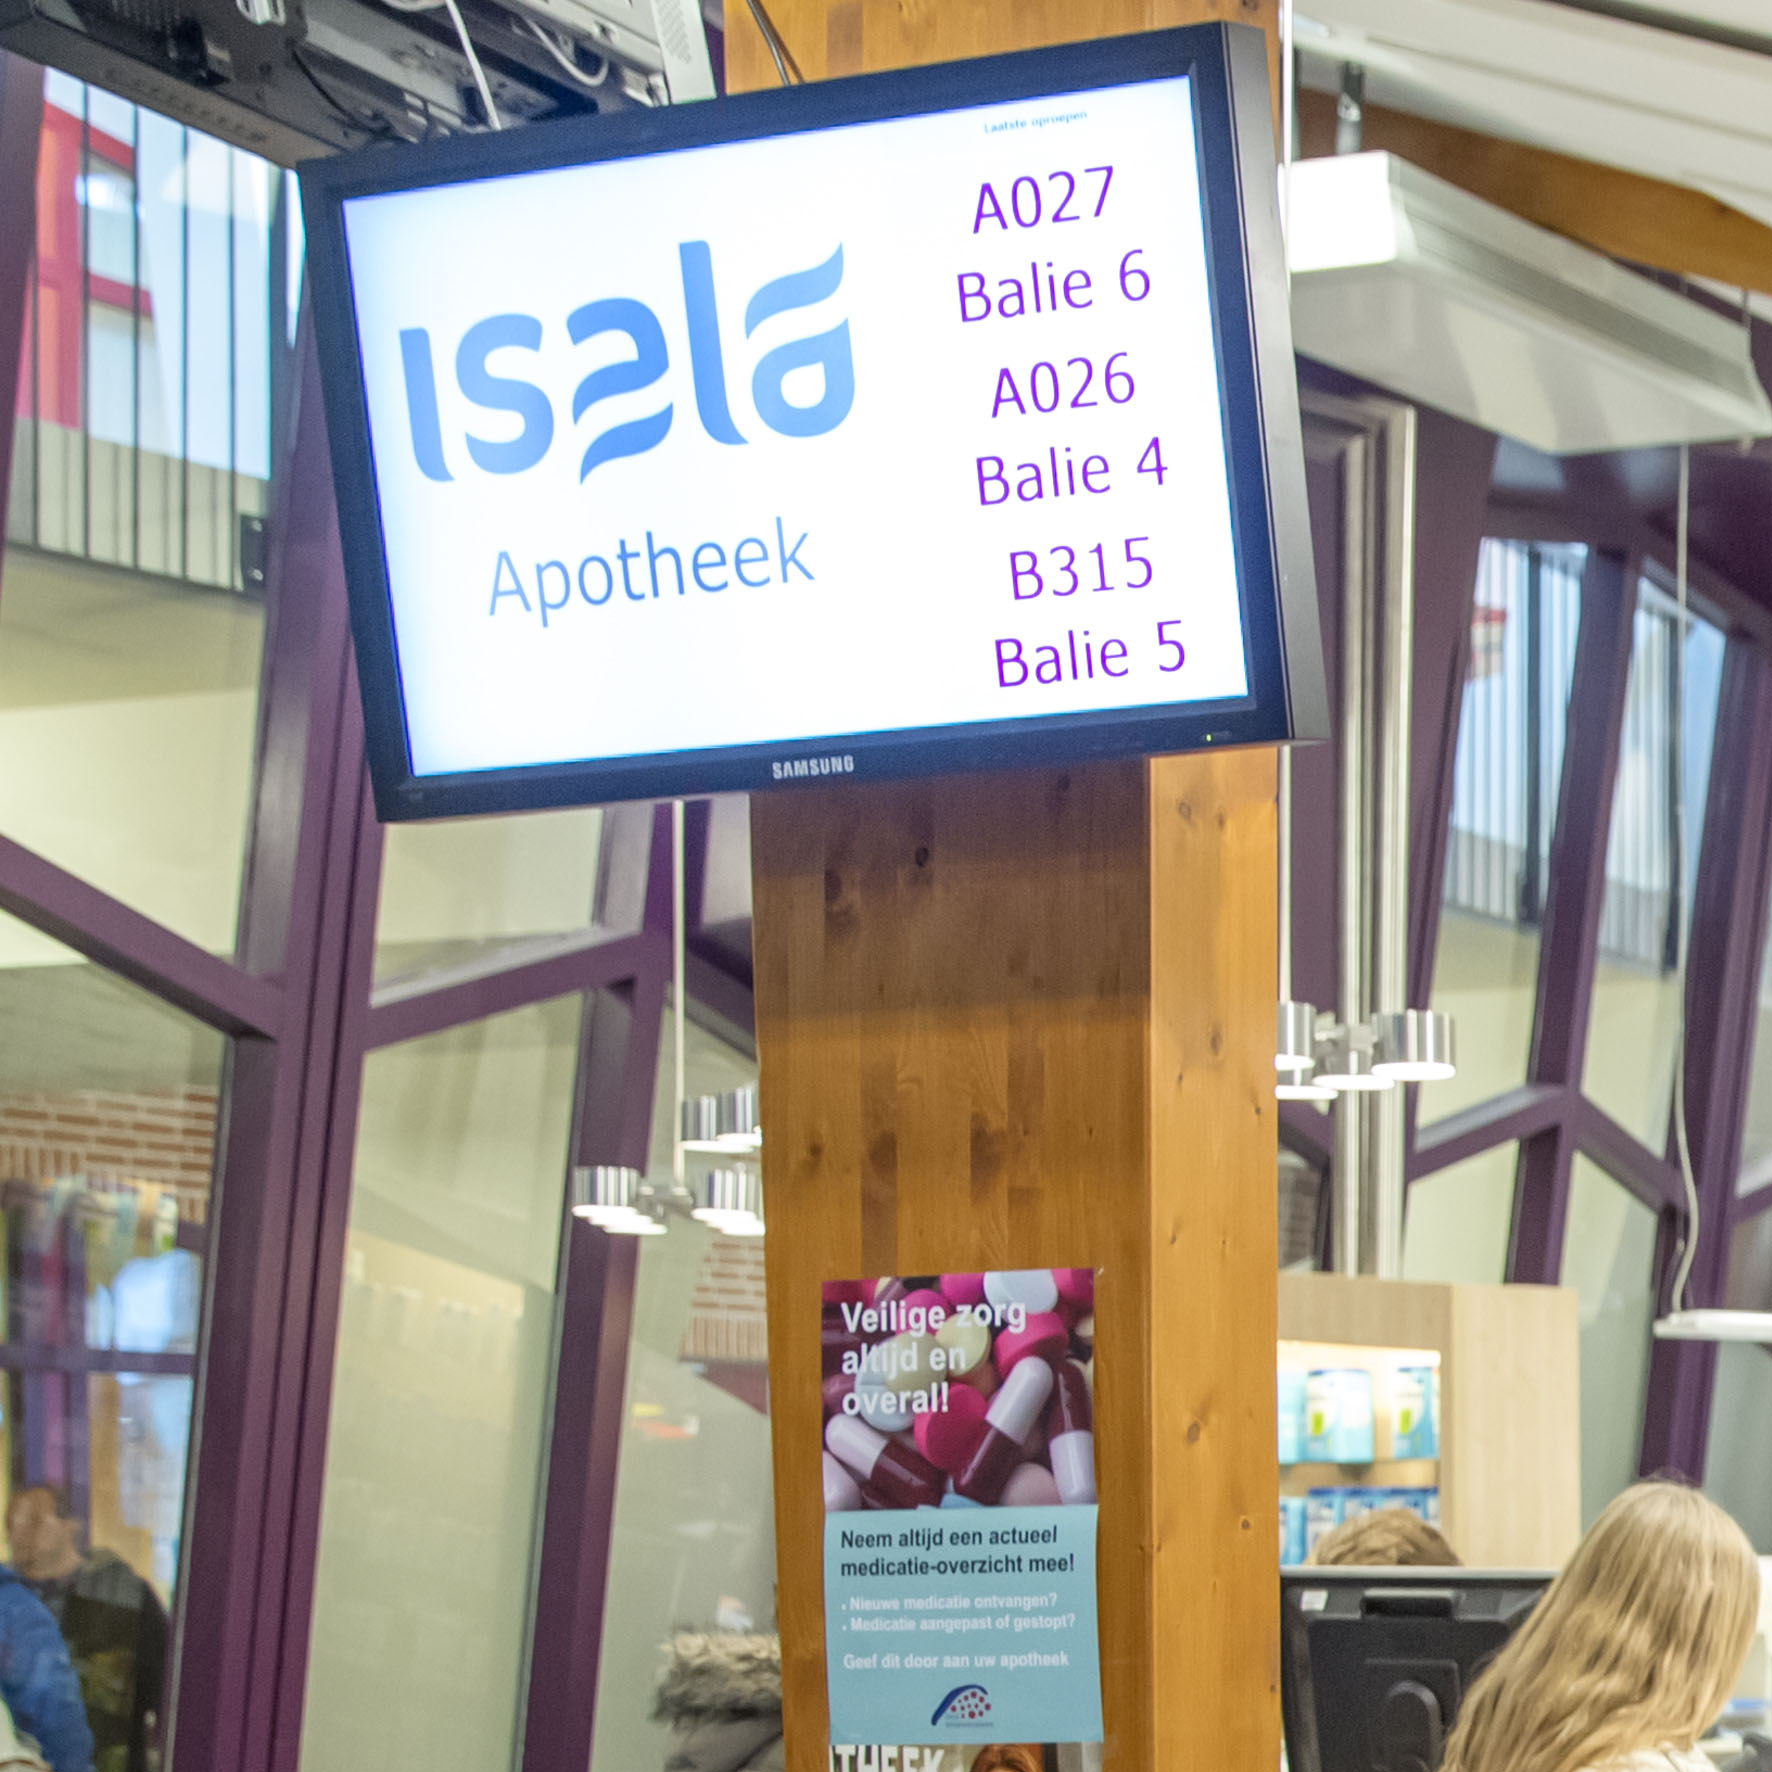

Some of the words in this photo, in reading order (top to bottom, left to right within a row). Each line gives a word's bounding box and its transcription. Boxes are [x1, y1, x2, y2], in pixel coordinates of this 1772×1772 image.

[972, 165, 1114, 235] A027
[956, 261, 1093, 323] Balie
[1119, 248, 1151, 302] 6
[991, 351, 1135, 419] A026
[975, 446, 1111, 507] Balie
[1136, 436, 1169, 486] 4
[489, 516, 815, 628] Apotheek
[1009, 536, 1153, 601] B315
[994, 629, 1129, 688] Balie
[1156, 619, 1185, 673] 5
[772, 754, 854, 780] SAMSUNG
[840, 1300, 946, 1337] Veilige
[955, 1302, 1026, 1334] zorg
[841, 1342, 918, 1381] altijd
[928, 1346, 967, 1372] en
[842, 1381, 949, 1416] overal!
[840, 1530, 893, 1549] Neem
[898, 1528, 944, 1551] altijd
[949, 1530, 983, 1545] een
[989, 1525, 1058, 1544] actueel
[841, 1555, 1023, 1577] medicatie-overzicht
[1028, 1553, 1075, 1573] mee!
[849, 1597, 900, 1611] Nieuwe
[904, 1596, 971, 1609] medicatie
[974, 1593, 1058, 1611] ontvangen?
[850, 1616, 916, 1631] Medicatie
[919, 1615, 992, 1633] aangepast
[995, 1614, 1010, 1629] of
[1013, 1613, 1076, 1632] gestopt?
[843, 1654, 878, 1669] Geef
[881, 1653, 900, 1668] dit
[904, 1654, 938, 1669] door
[942, 1655, 970, 1668] aan
[973, 1654, 996, 1667] uw
[1000, 1651, 1068, 1670] apotheek
